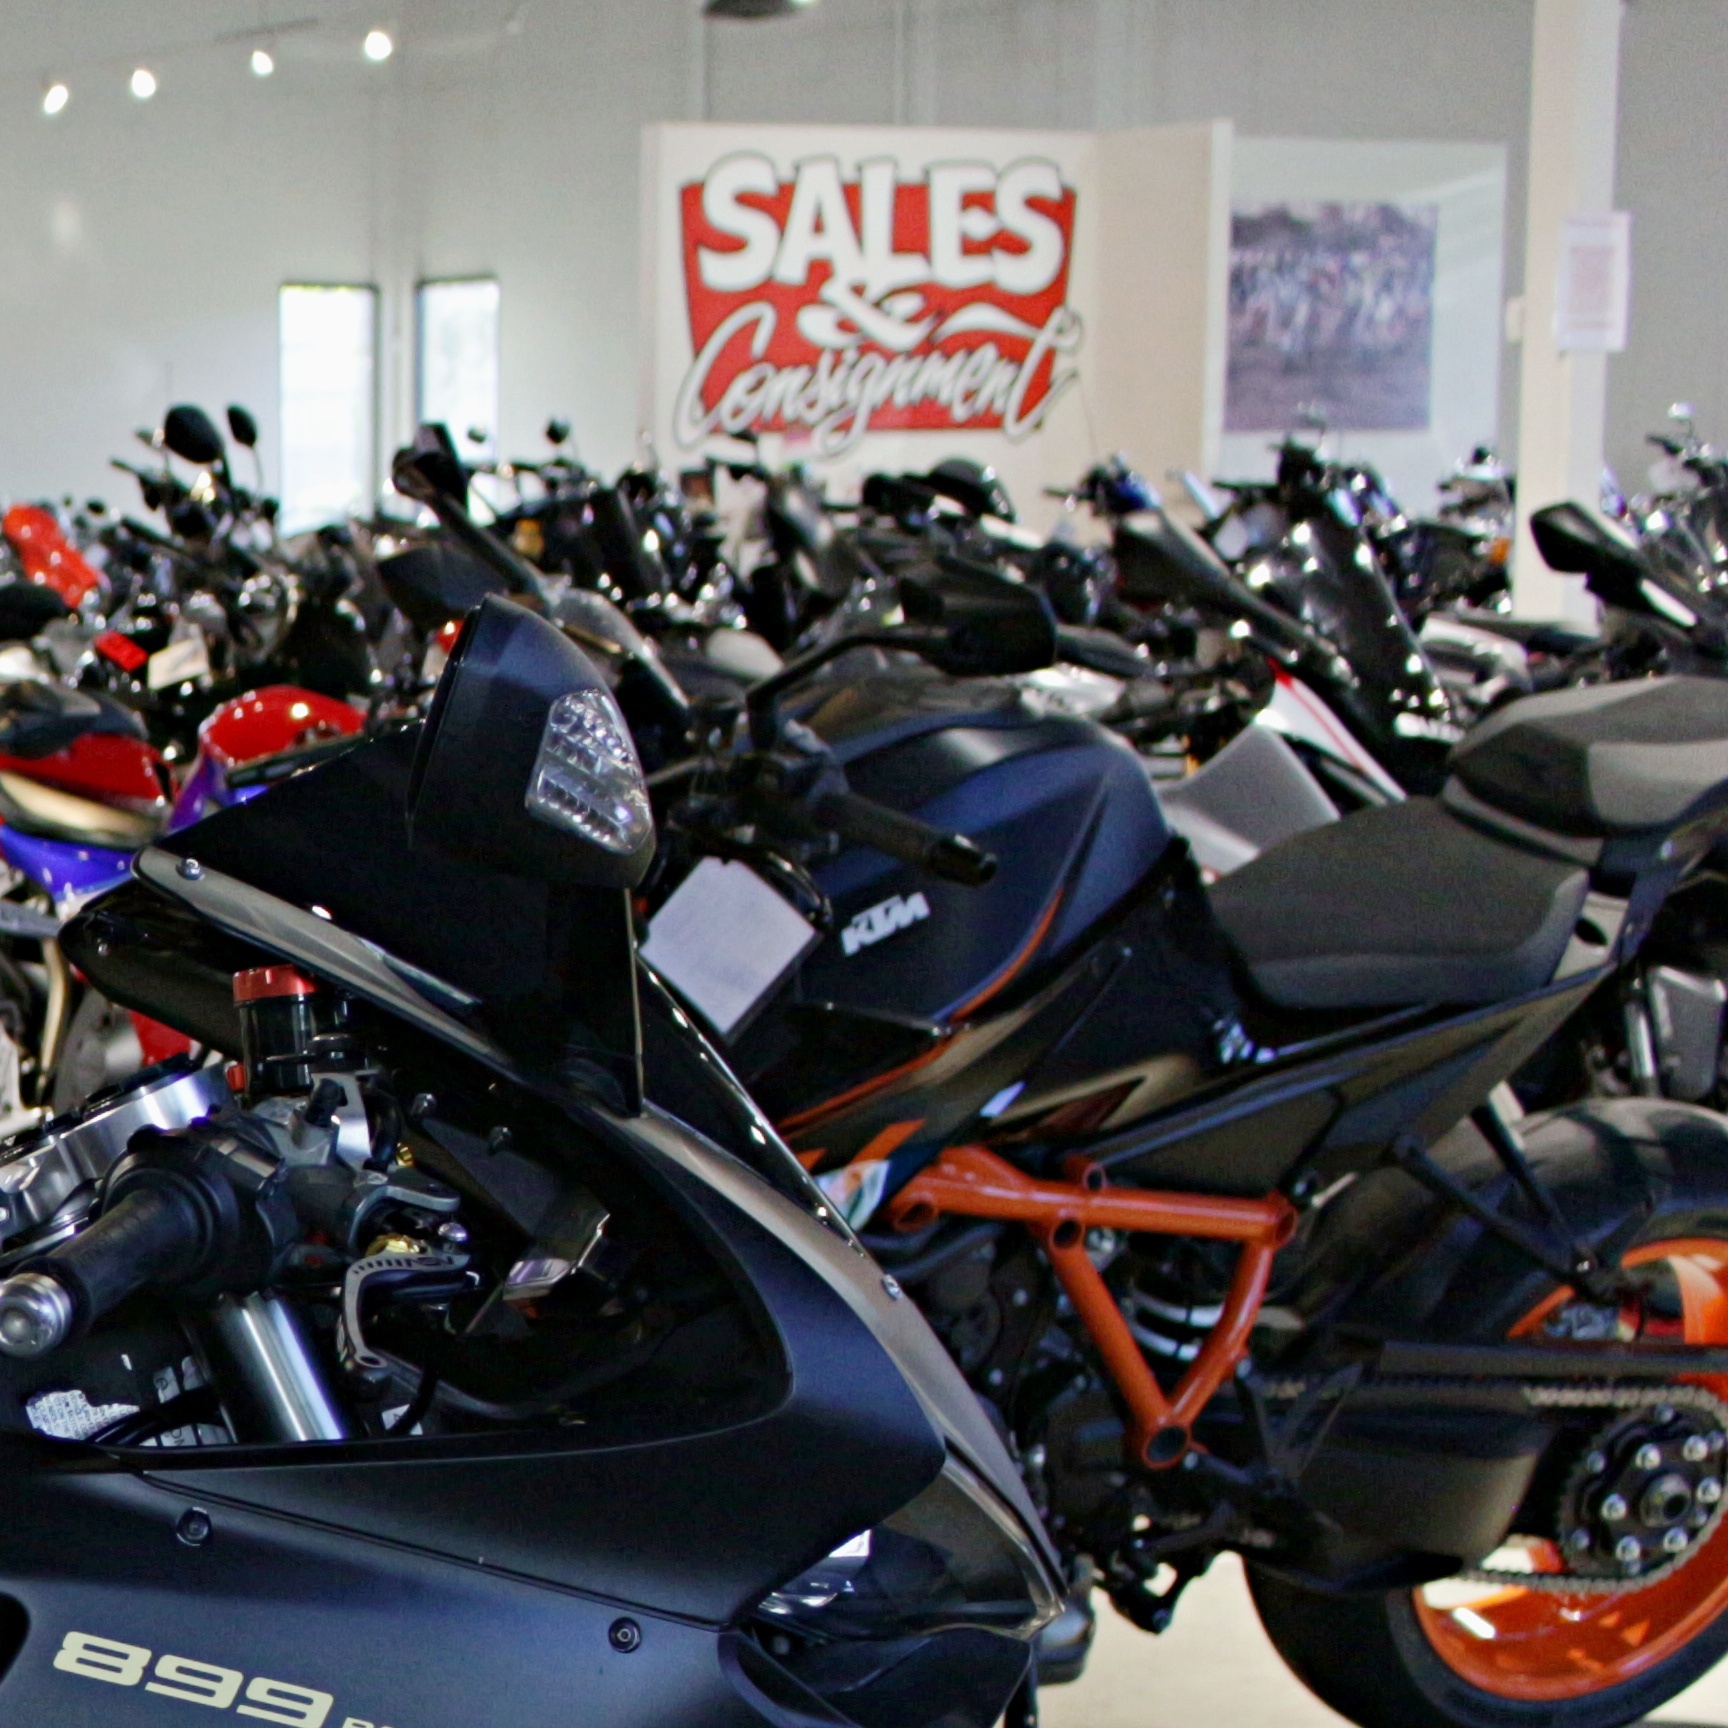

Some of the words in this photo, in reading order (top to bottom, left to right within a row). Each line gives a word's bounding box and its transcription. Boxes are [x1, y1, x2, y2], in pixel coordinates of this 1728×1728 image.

[696, 149, 1066, 296] SALES
[796, 273, 940, 352] &
[674, 298, 1082, 456] Consignment
[840, 891, 932, 957] KTM
